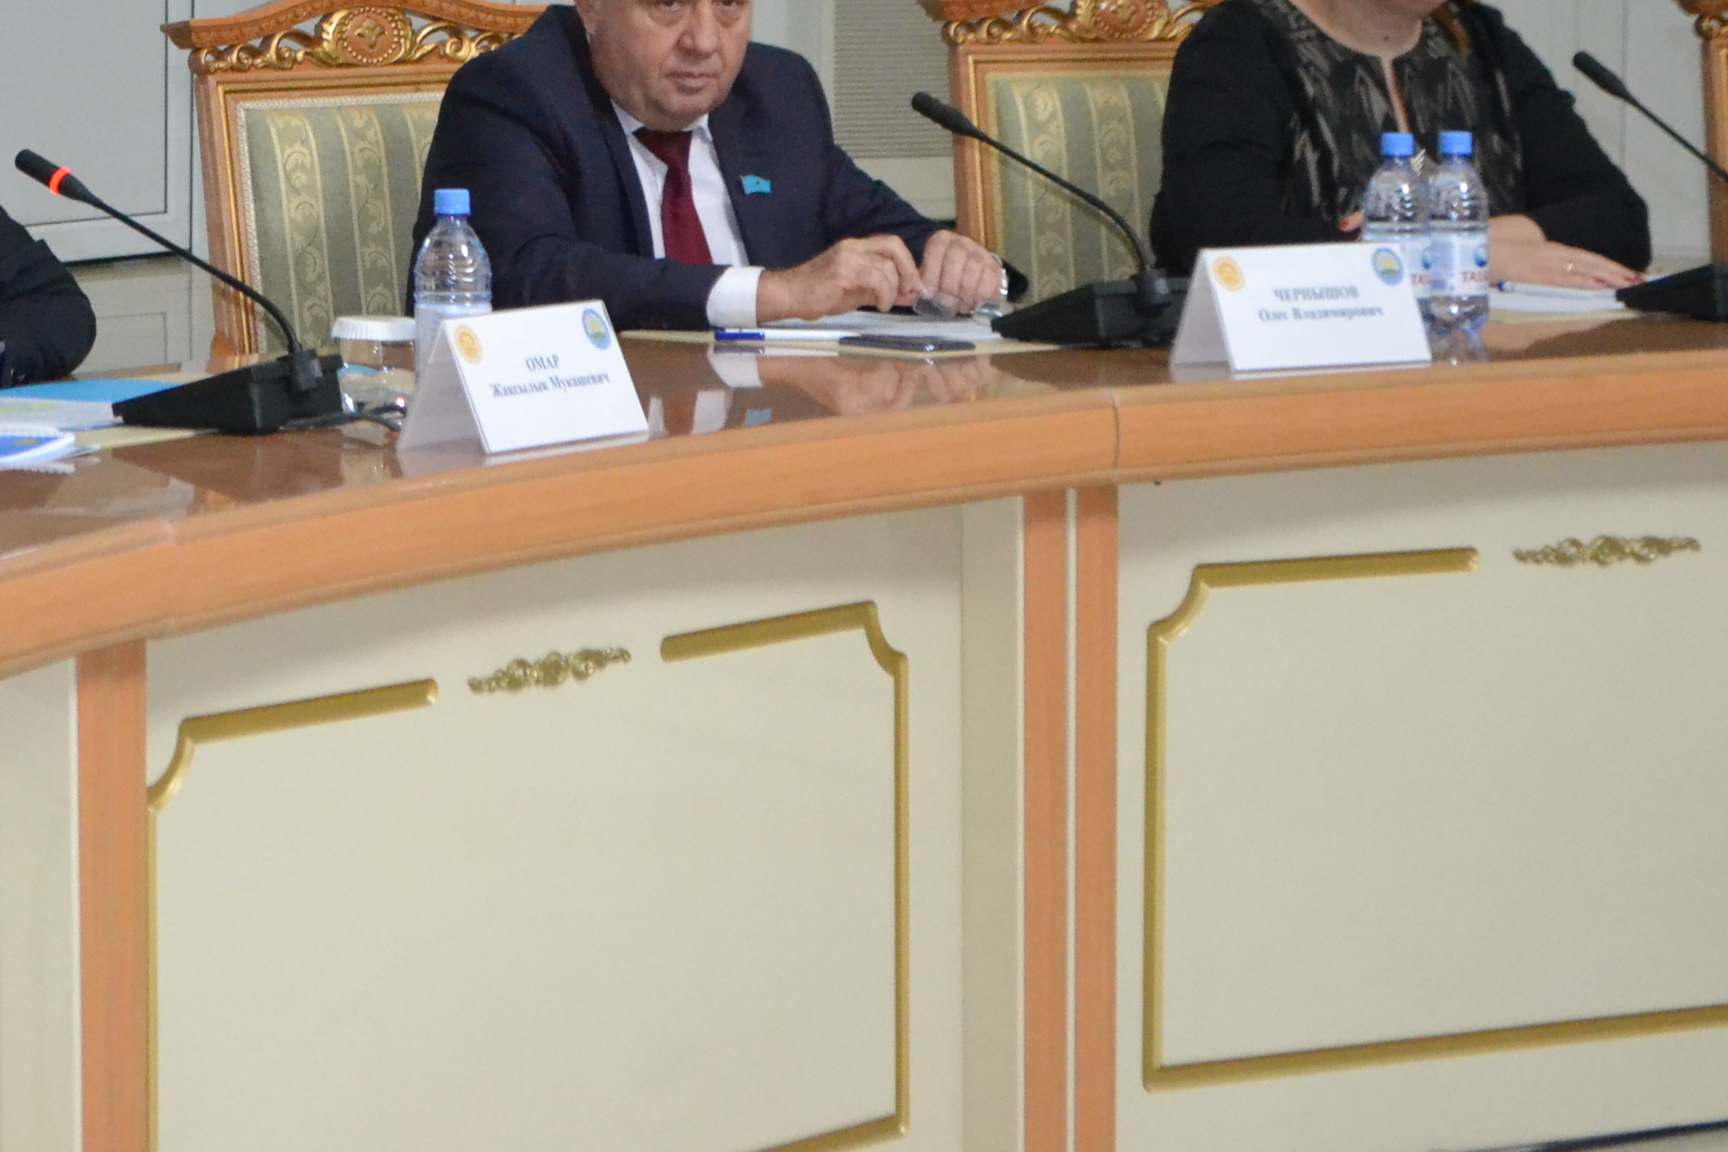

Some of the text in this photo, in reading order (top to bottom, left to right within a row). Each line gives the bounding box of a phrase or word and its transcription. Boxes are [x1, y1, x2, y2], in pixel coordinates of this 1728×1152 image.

[526, 355, 559, 371] ОМАР
[491, 373, 610, 398] Жаксылык Мукашевич
